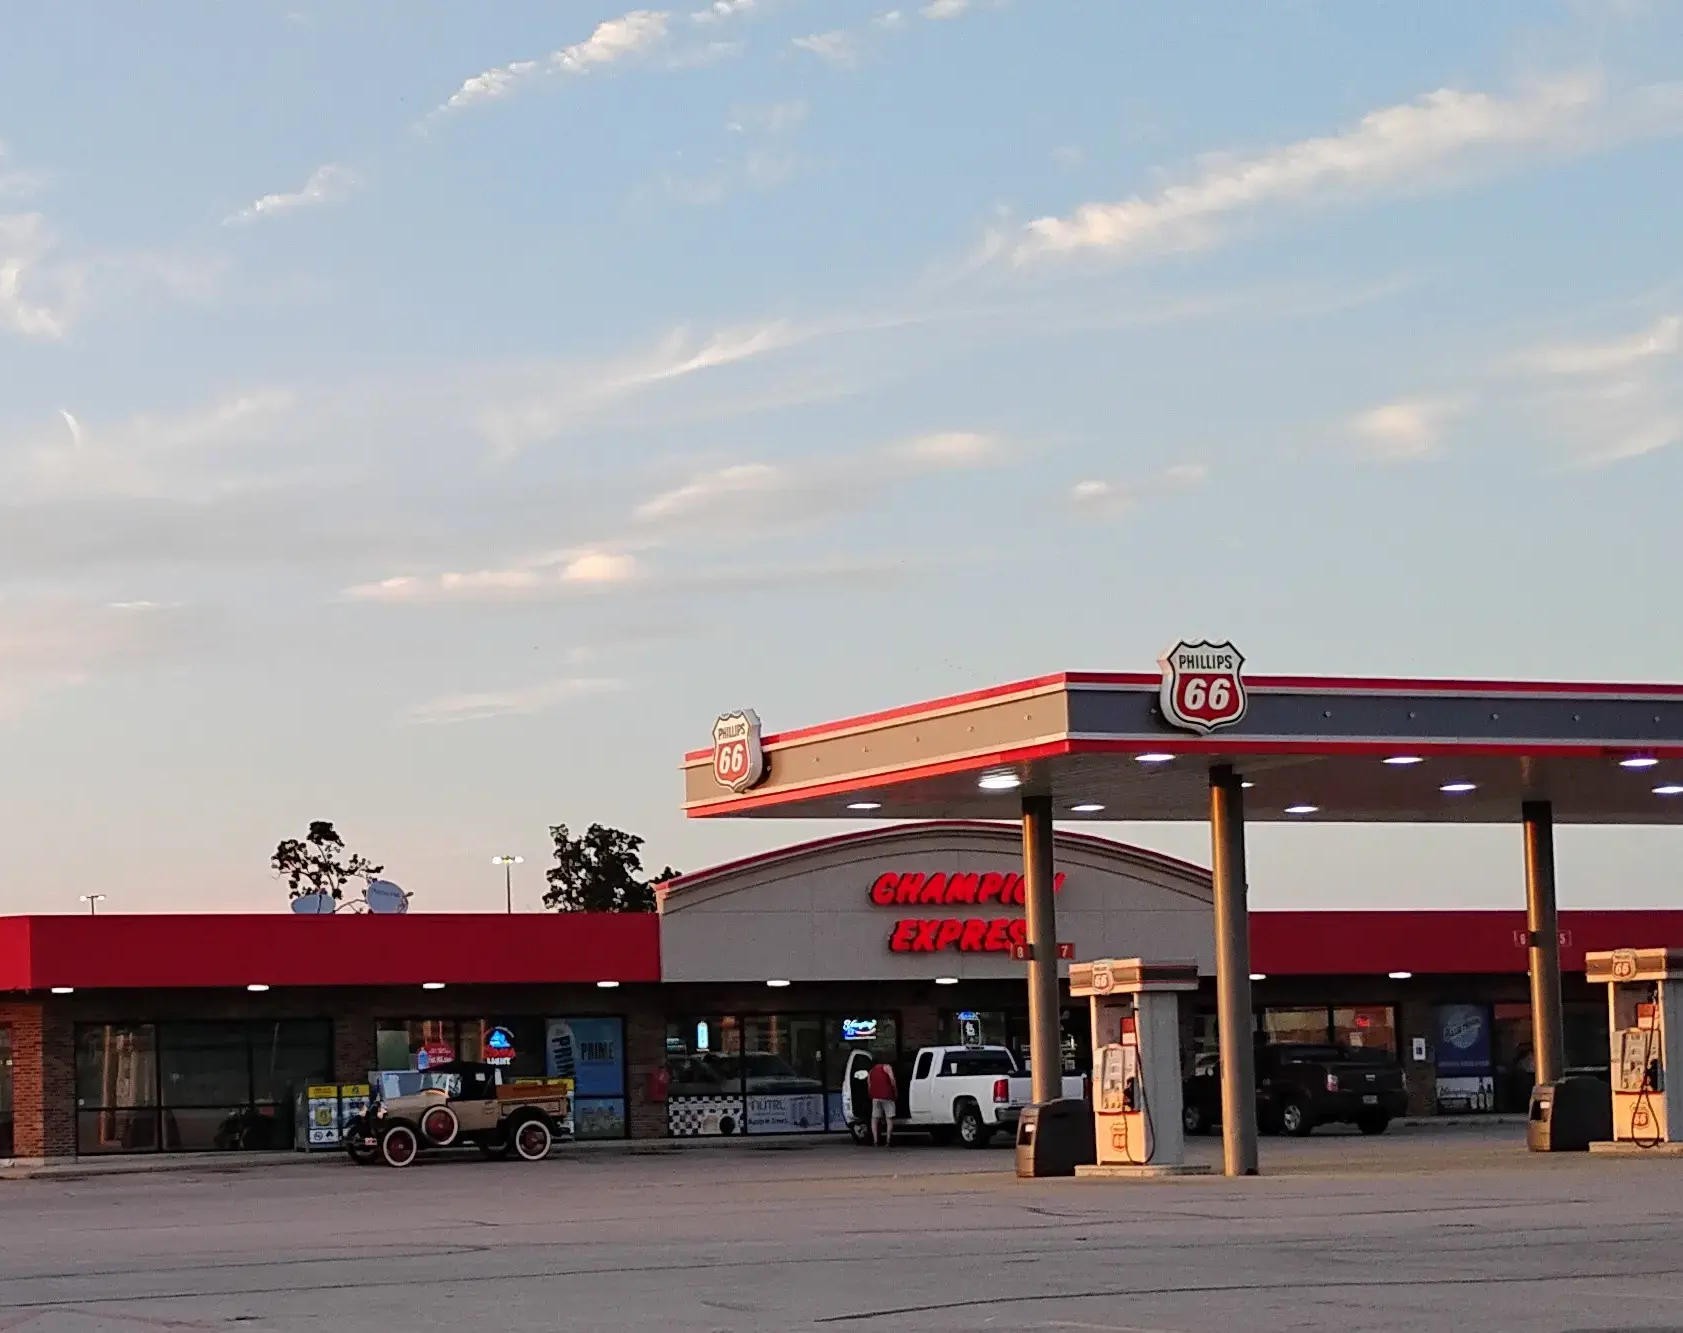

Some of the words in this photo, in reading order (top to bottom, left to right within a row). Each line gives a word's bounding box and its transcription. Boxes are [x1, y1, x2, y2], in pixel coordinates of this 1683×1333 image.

[1179, 654, 1233, 670] PHILLIPS
[1184, 677, 1231, 711] 66
[718, 722, 746, 741] PHILLIPS
[719, 743, 744, 775] 66
[870, 871, 1066, 905] CHAMPI
[890, 917, 1027, 952] EXPRES
[1061, 945, 1069, 958] 7
[1615, 962, 1631, 976] 66
[1094, 973, 1108, 988] 66
[580, 1041, 615, 1061] PRIME
[487, 1057, 512, 1066] LIGHT
